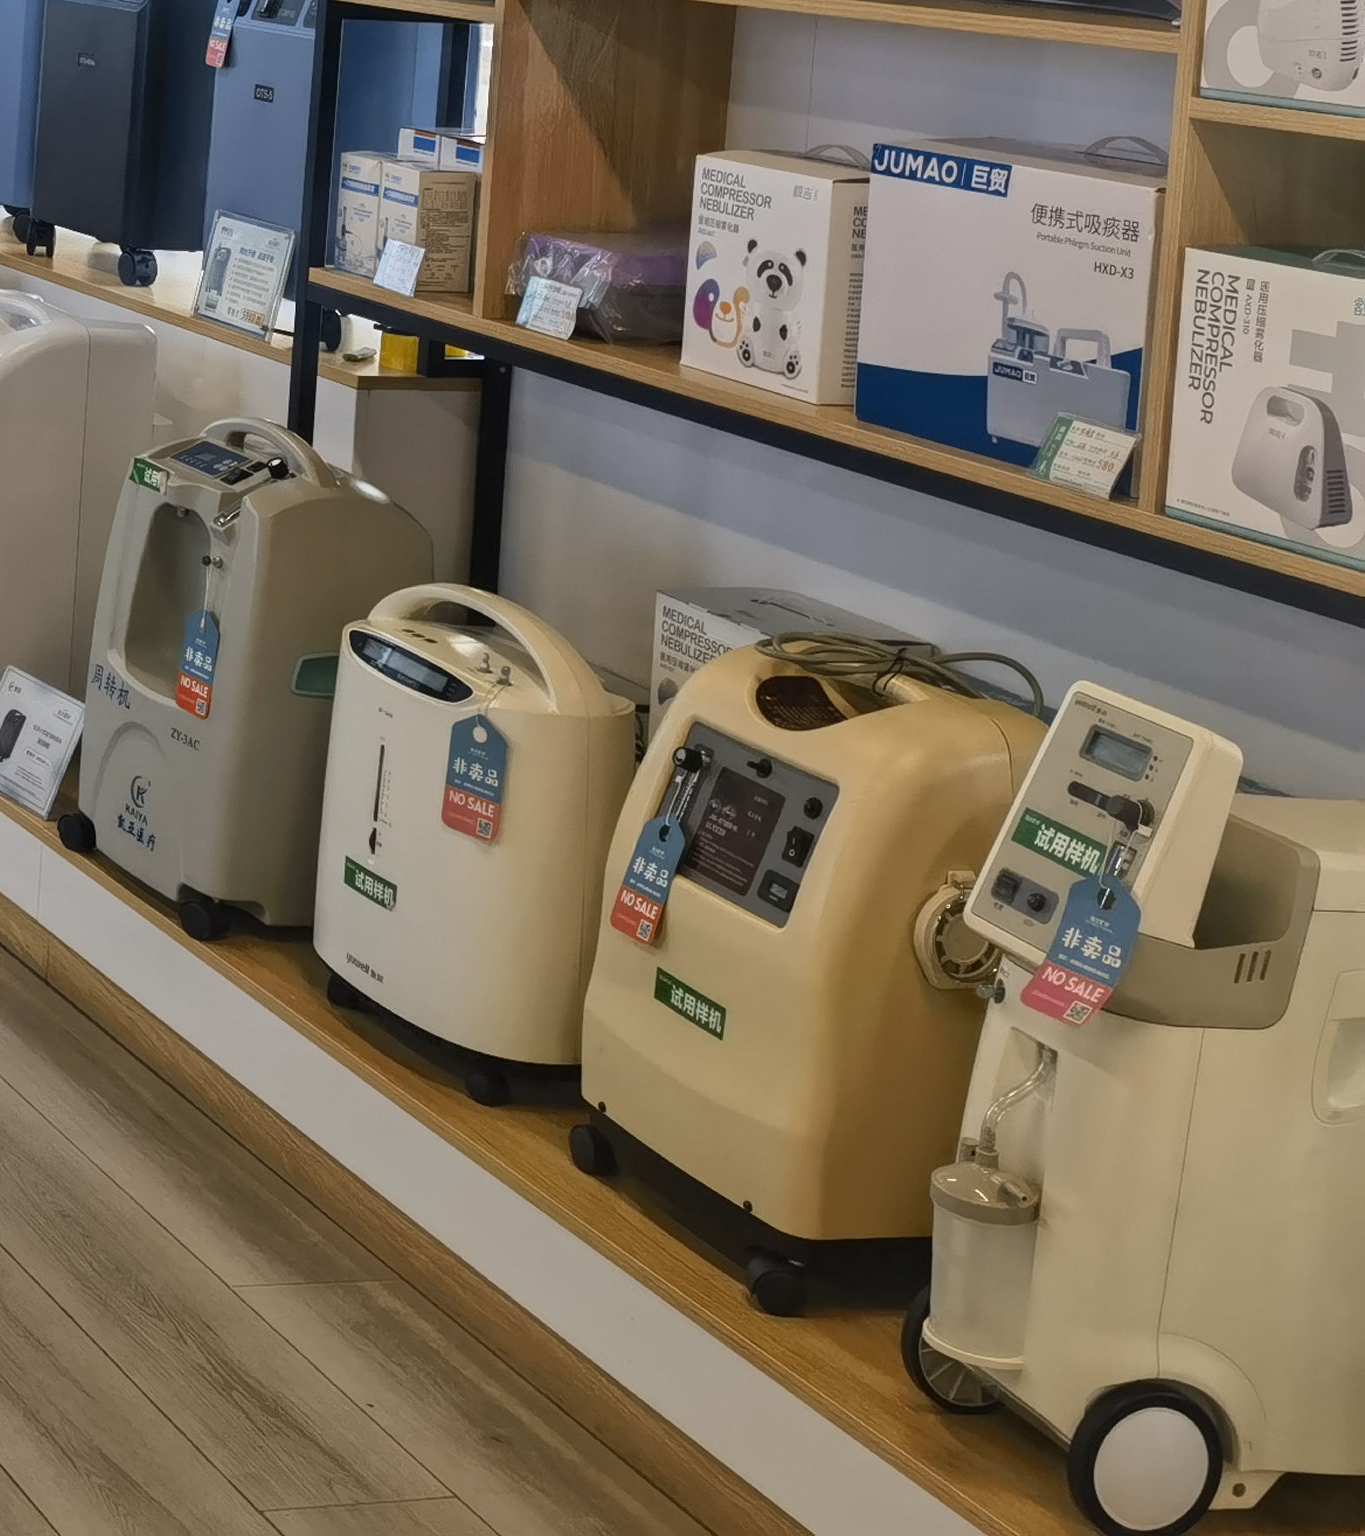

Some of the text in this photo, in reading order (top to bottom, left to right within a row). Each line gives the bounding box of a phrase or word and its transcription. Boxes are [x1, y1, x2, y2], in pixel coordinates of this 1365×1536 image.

[701, 167, 747, 189] MEDICAL
[873, 148, 1008, 194] JUMAO 巨贸
[699, 196, 755, 221] NEBULIZER
[700, 182, 772, 209] COMPRESSOR
[1030, 203, 1141, 243] 便携式吸痰器
[1036, 231, 1064, 245] Portable
[1090, 241, 1117, 255] Suction
[1117, 245, 1131, 257] Unit
[1093, 261, 1135, 279] HXD-X3
[1187, 268, 1211, 392] NEBULIZER
[1218, 274, 1241, 373] MEDICAL
[1199, 271, 1225, 425] COMPRESSOR
[662, 605, 707, 636] MEDICAL
[91, 664, 131, 710] 周转机
[180, 674, 209, 699] NO SALE
[170, 726, 201, 752] ZY-3AC
[452, 756, 499, 788] 非卖品
[125, 803, 149, 827] KAIYA
[449, 789, 495, 819] NO SALE
[1033, 822, 1101, 876] 试用样机
[632, 855, 668, 889] 非卖品
[354, 868, 395, 910] 试用样机
[620, 888, 659, 921] NO SALE
[1061, 926, 1123, 969] 非卖品
[1042, 965, 1105, 1004] NO SALE
[669, 984, 723, 1033] 试用样机
